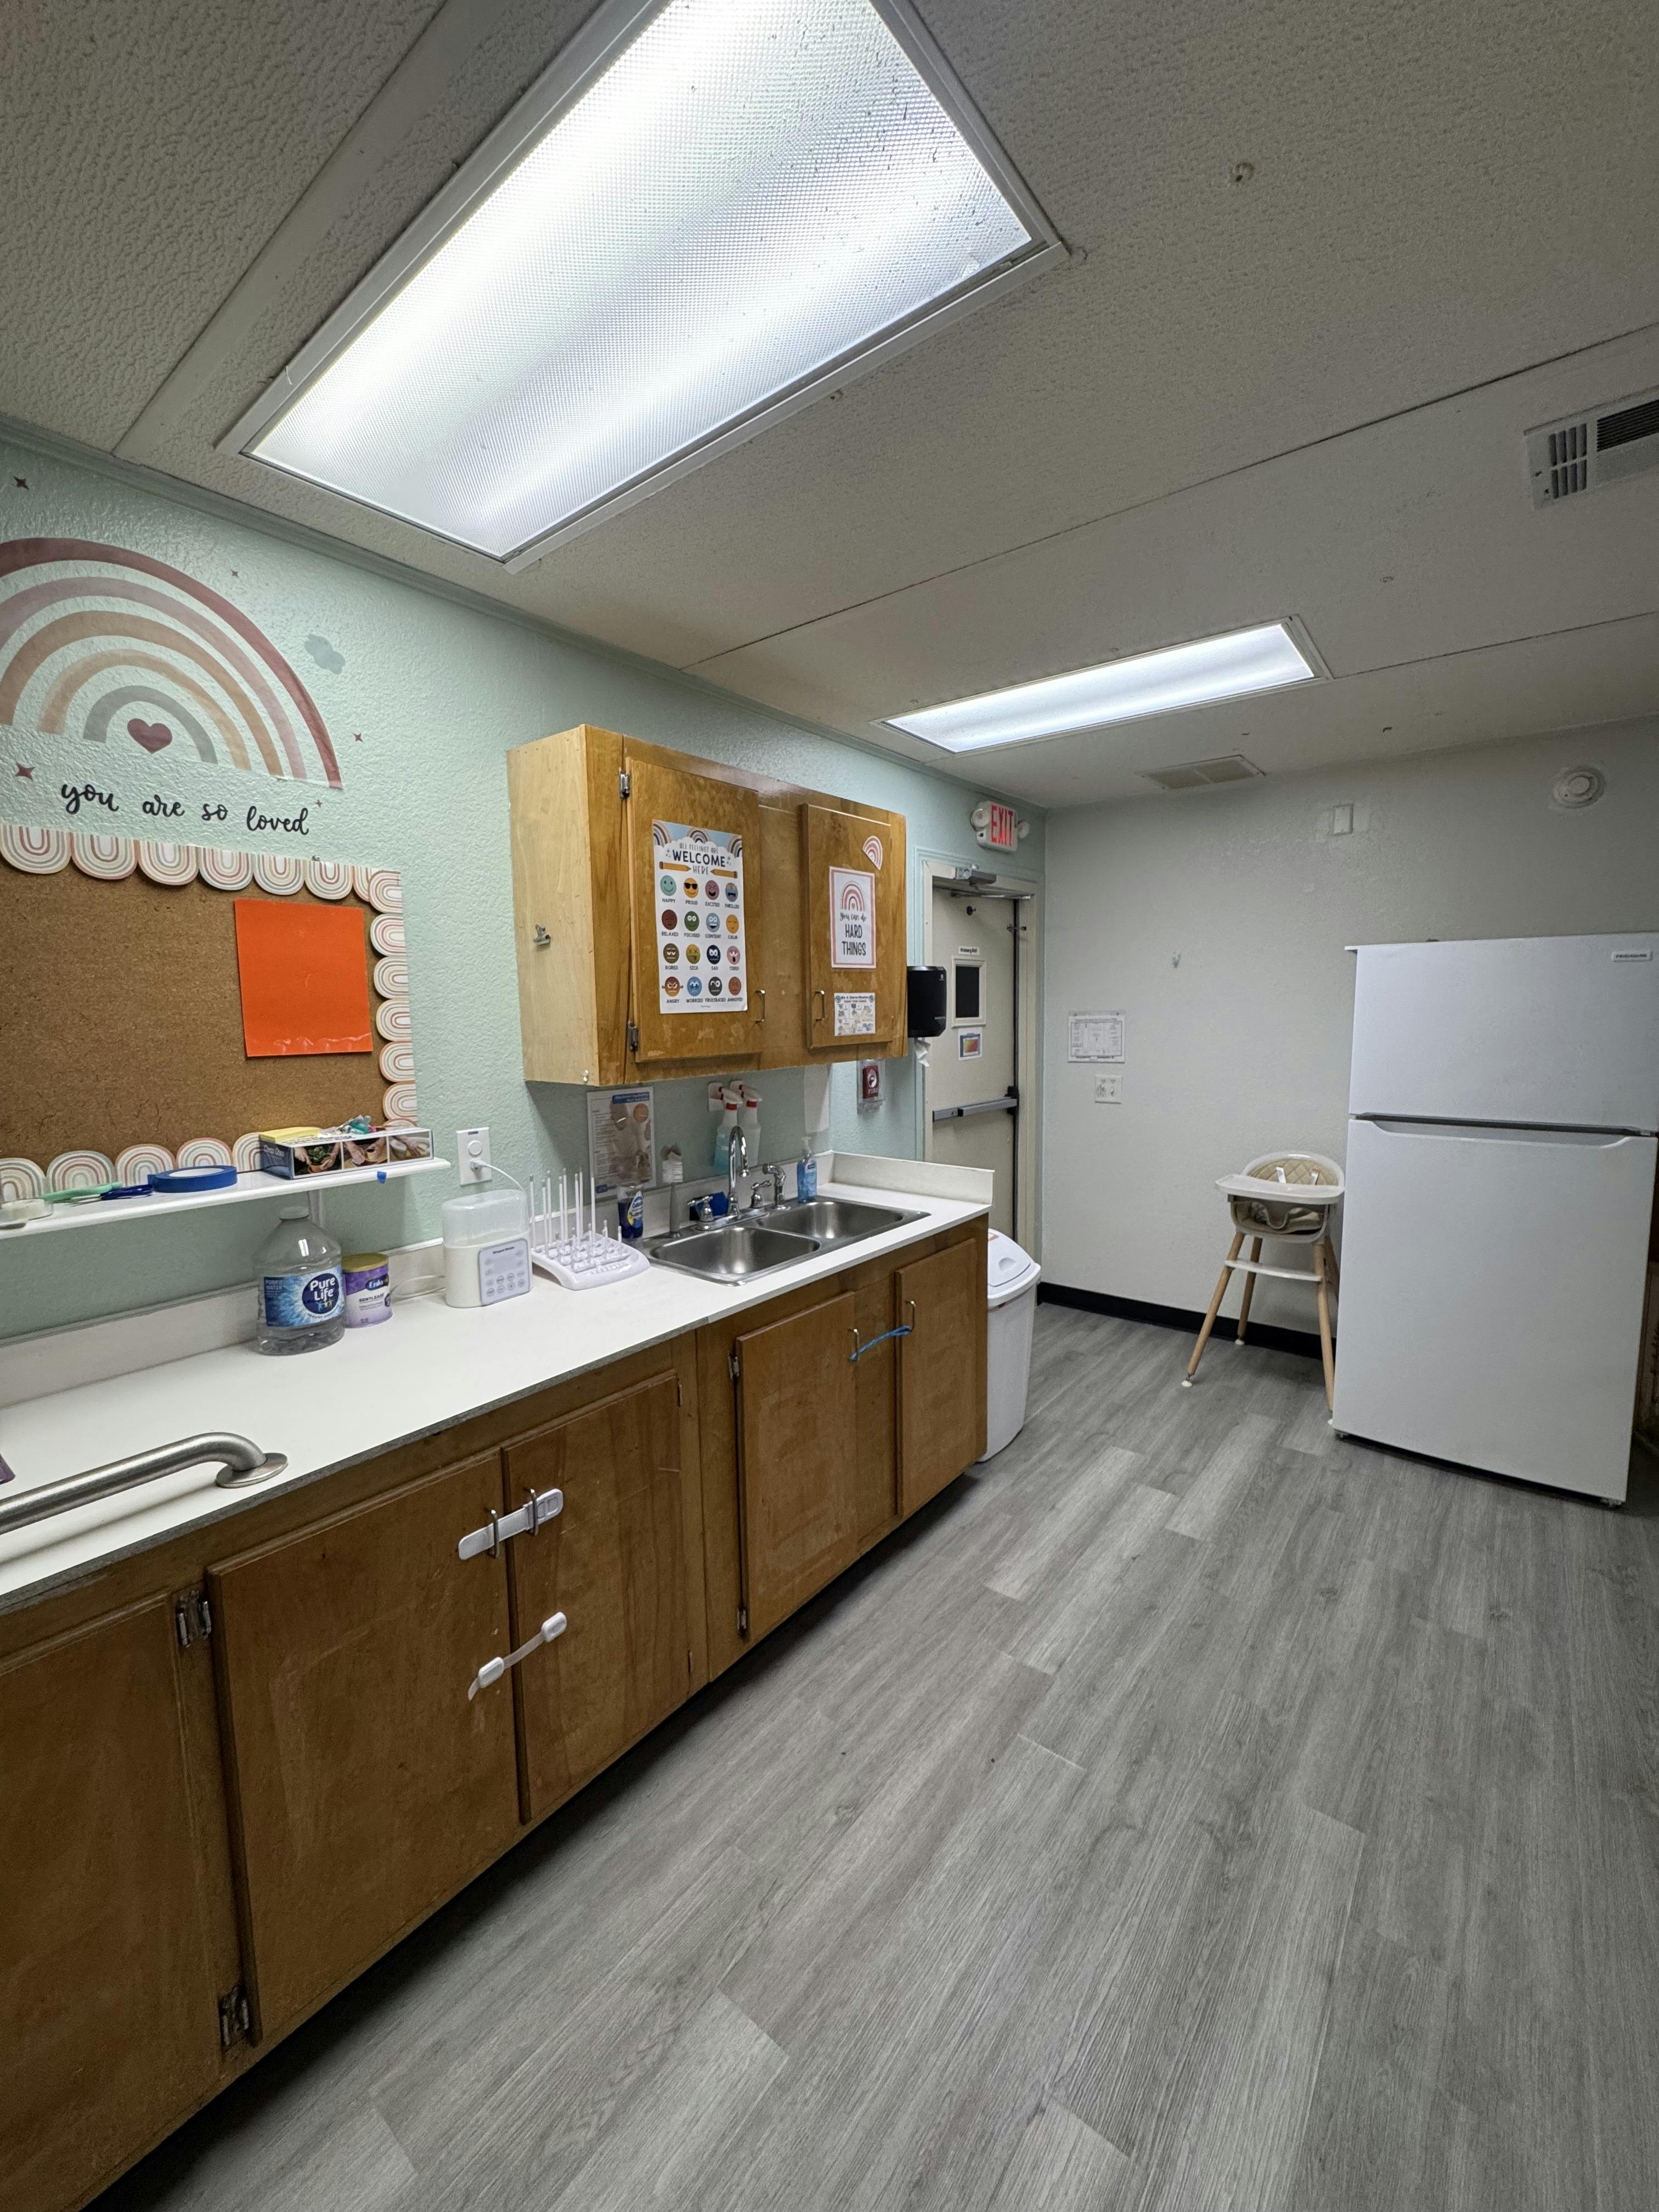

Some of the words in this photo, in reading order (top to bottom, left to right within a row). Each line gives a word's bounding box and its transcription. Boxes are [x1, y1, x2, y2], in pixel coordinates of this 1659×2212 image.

[61, 784, 119, 815] you
[142, 794, 184, 817] are
[201, 803, 228, 821] so
[246, 805, 309, 836] loved
[991, 804, 1013, 846] EXIT
[673, 849, 725, 867] WELCOME
[693, 865, 709, 875] HERE
[861, 912, 866, 922] do
[845, 924, 862, 939] HARD
[842, 941, 866, 956] THINGS
[310, 1277, 335, 1291] Pure
[314, 1288, 334, 1301] Life
